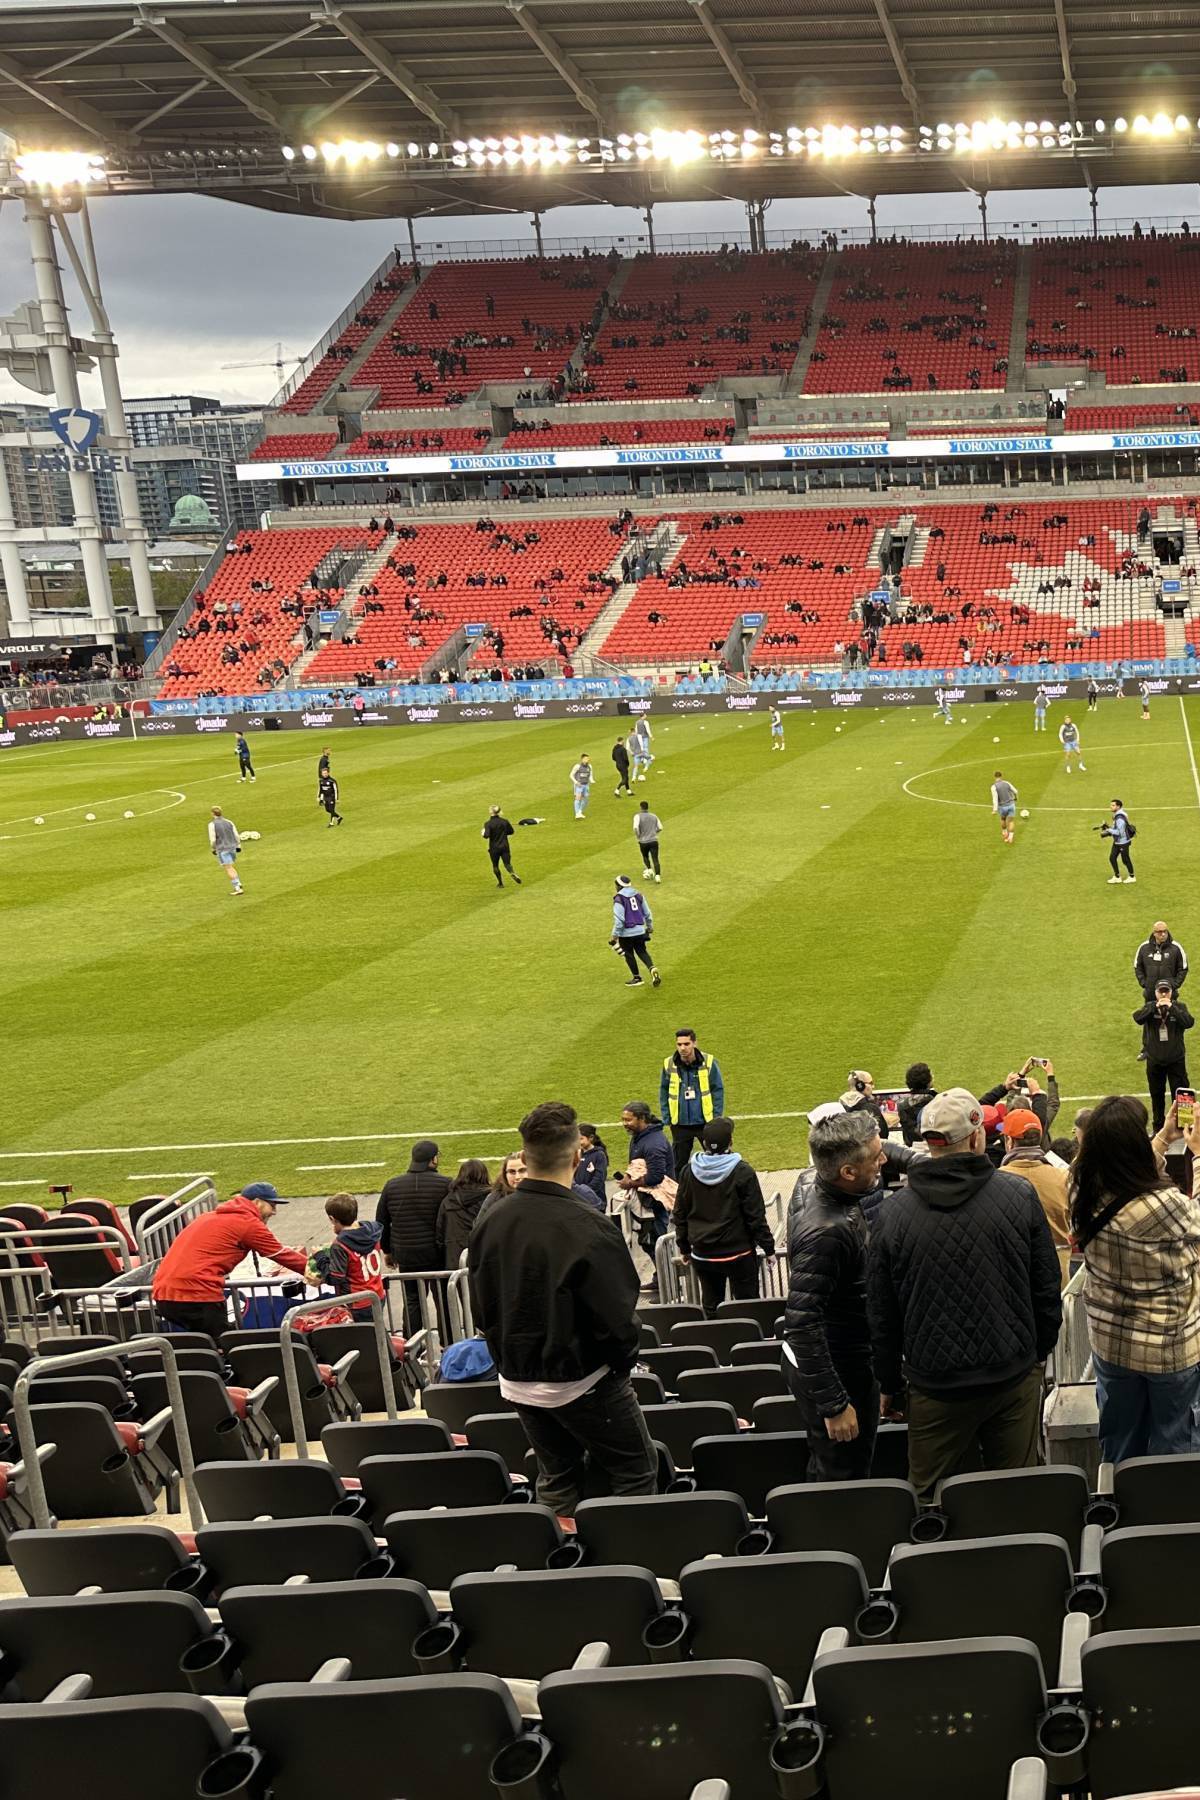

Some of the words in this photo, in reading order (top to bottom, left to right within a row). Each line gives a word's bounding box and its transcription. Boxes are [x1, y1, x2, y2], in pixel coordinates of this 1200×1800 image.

[954, 439, 1013, 452] TORONTO
[1016, 438, 1047, 450] STAR
[1117, 433, 1175, 447] TORONTO
[622, 449, 681, 462] TORONTO
[685, 448, 717, 460] STAR
[790, 444, 848, 457] TORONTO
[851, 443, 883, 455] STAR
[287, 462, 347, 475] TORONTO
[351, 461, 383, 473] STAR
[455, 455, 516, 468] TORONTO
[518, 454, 550, 466] STAR
[629, 896, 639, 911] 8
[359, 1250, 381, 1282] 10
